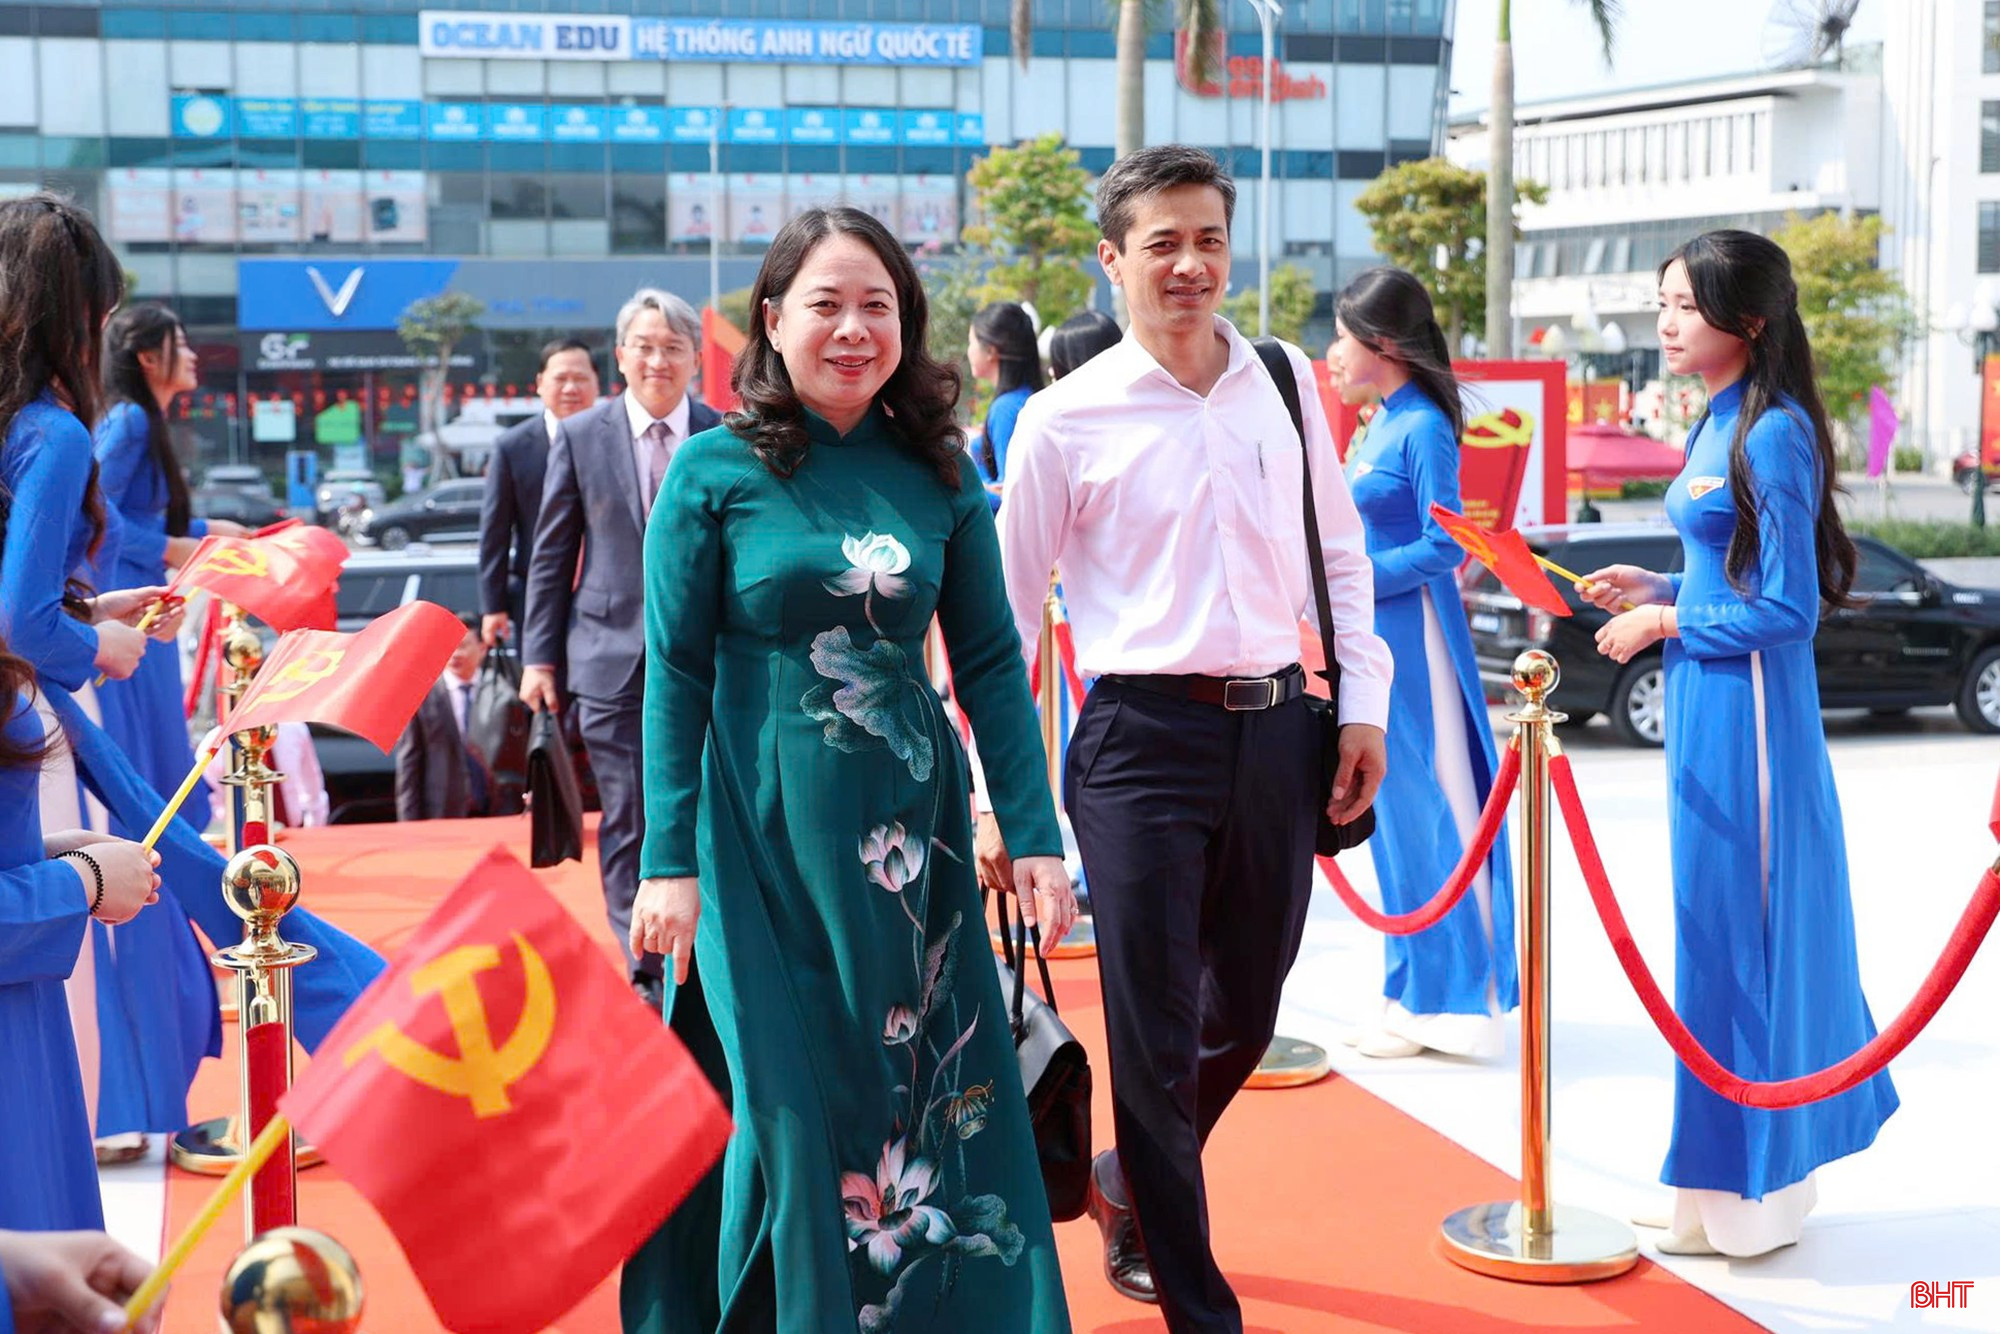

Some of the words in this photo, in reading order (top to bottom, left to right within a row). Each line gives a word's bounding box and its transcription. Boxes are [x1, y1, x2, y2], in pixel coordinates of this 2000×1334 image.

[432, 22, 543, 50] OCEAN
[556, 25, 620, 51] EDU
[635, 20, 669, 59] HỆ
[673, 19, 757, 56] THỐNG
[761, 27, 814, 57] ANH
[819, 23, 873, 58] NGỮ
[877, 25, 941, 61] QUỐC
[944, 26, 974, 60] TẾ
